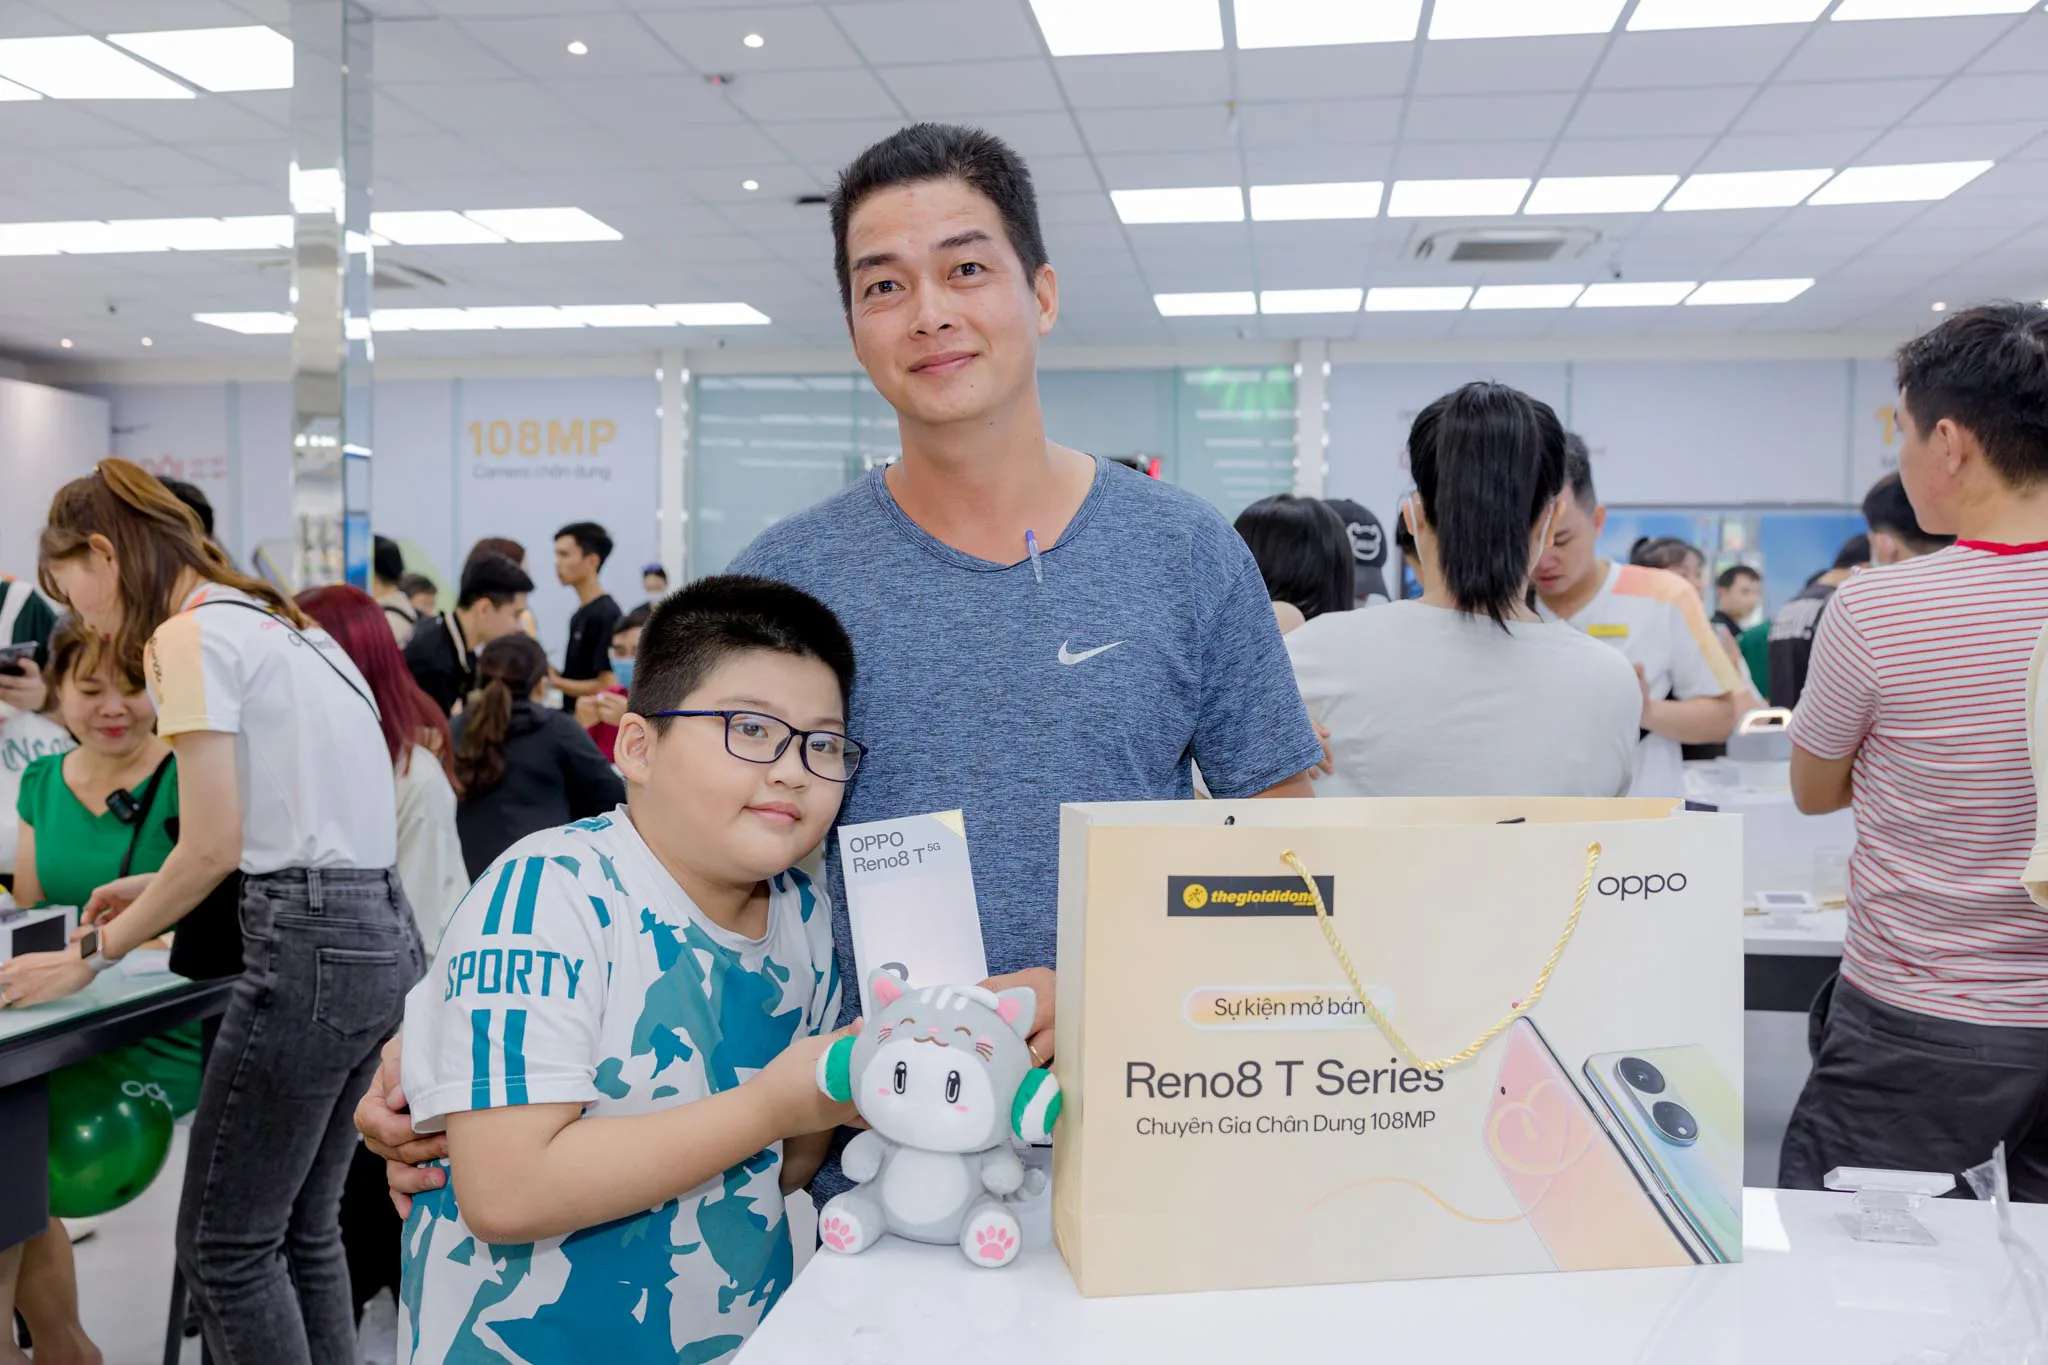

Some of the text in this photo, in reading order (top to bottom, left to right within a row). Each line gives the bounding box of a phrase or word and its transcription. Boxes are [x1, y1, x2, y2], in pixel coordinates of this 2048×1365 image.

[468, 418, 617, 458] 108MP
[850, 832, 904, 853] OPPO
[853, 842, 941, 873] Reno8 T 5G
[1598, 872, 1687, 901] oppo
[444, 949, 584, 1002] SPORTY
[1214, 995, 1366, 1021] Sự kiện mở bán
[1126, 1057, 1445, 1099] Reno8 T Series
[1136, 1110, 1436, 1139] Chuyên Gia Chân Dung 108MP
